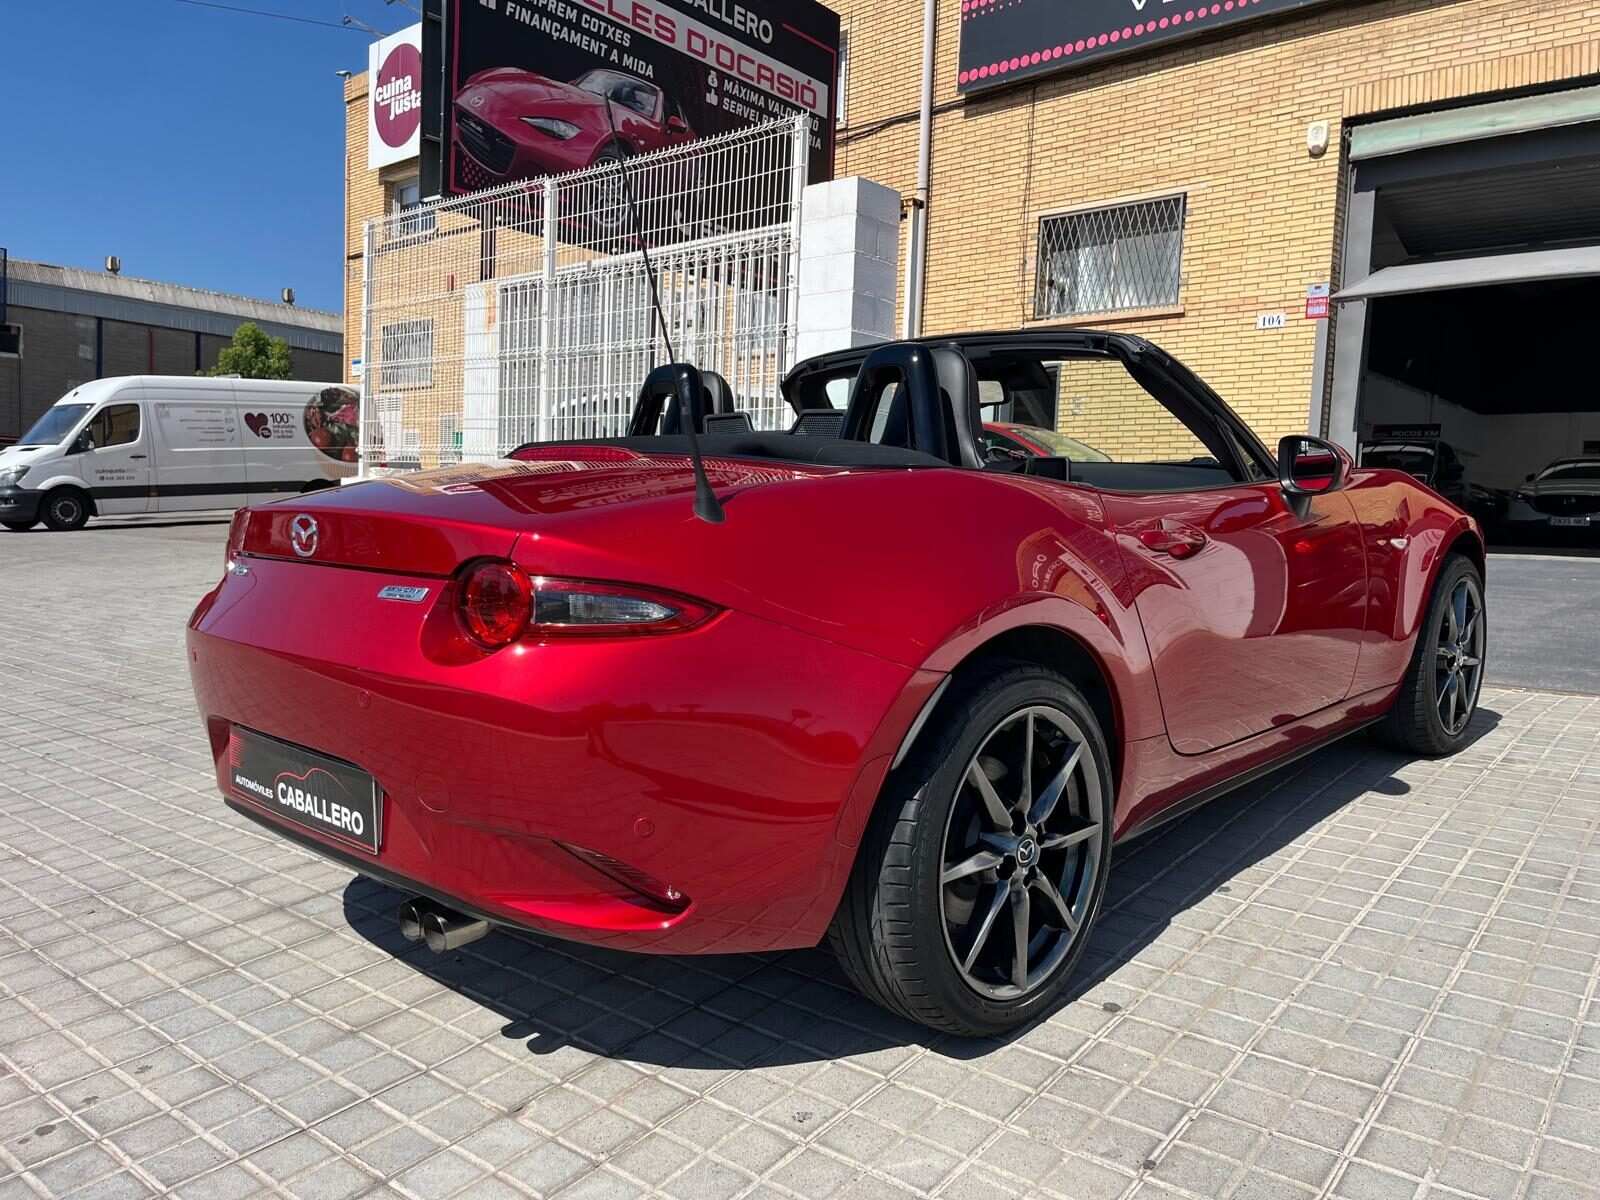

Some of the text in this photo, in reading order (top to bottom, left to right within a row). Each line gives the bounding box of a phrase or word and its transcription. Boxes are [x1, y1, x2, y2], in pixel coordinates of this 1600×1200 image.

[581, 13, 631, 48] COTXES
[683, 0, 773, 44] LLERO
[505, 1, 654, 79] FINANÇAMENT A MIDA
[687, 28, 817, 110] D'OCASIÓ
[375, 75, 412, 103] cuina
[389, 89, 421, 121] justa
[723, 79, 765, 108] MÀXIMA
[722, 97, 759, 123] SERVEI
[1262, 315, 1281, 327] 104
[1424, 429, 1439, 437] KM
[235, 774, 364, 836] AUTOMÓVILES CABALLERO
